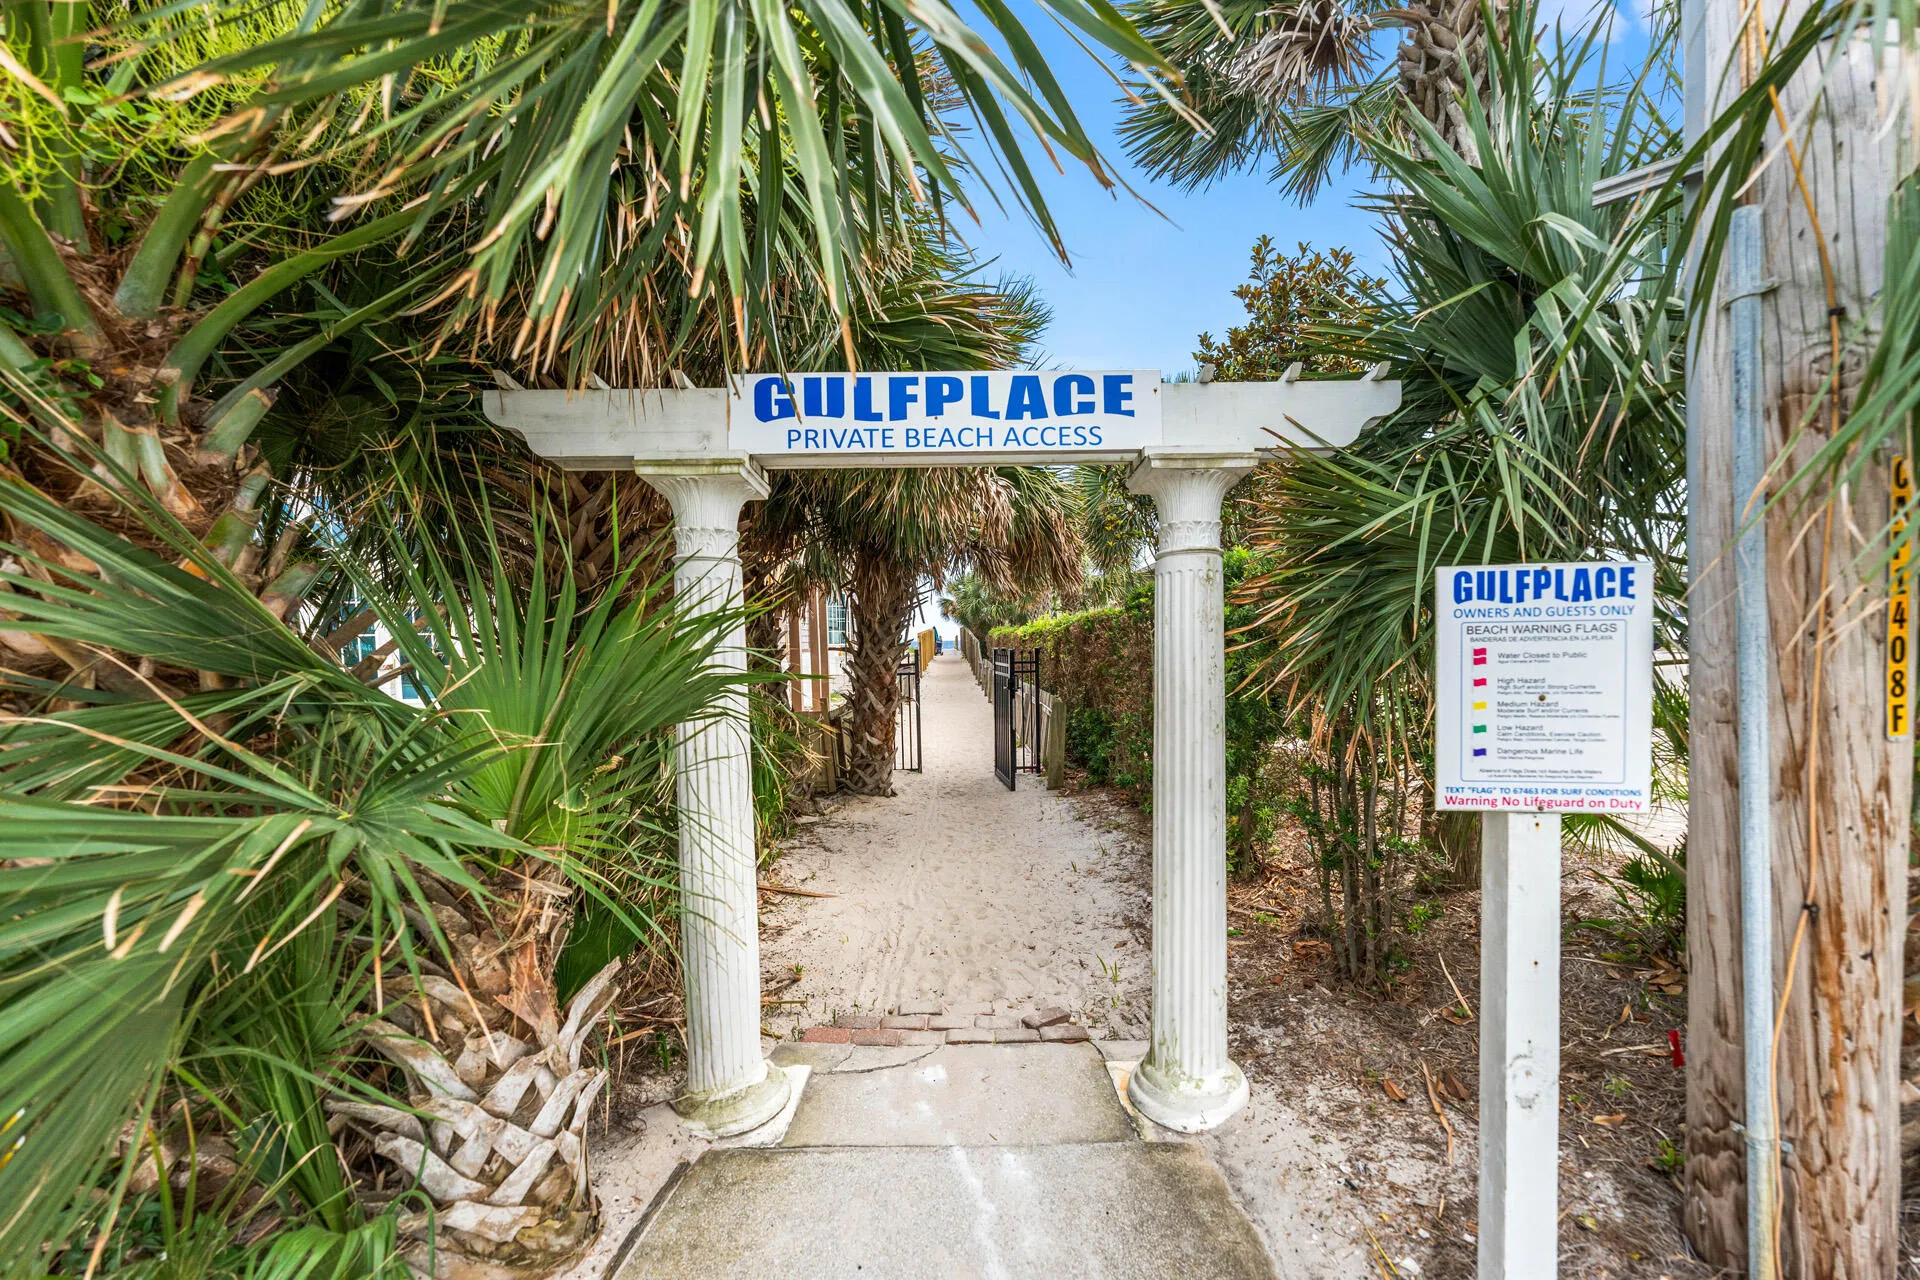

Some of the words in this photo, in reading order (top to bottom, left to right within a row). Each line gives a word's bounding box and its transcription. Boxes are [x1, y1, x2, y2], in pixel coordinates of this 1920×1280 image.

[754, 374, 1135, 423] GULFPLACE
[787, 427, 895, 449] PRIVATE
[905, 426, 993, 448] BEACH
[1003, 425, 1103, 447] ACCESS
[1453, 566, 1635, 605] GULFPLACE
[1453, 607, 1510, 619] OWNERS
[1513, 607, 1543, 618] AND
[1545, 606, 1597, 617] GUESTS
[1600, 605, 1635, 616] ONLY
[1466, 625, 1508, 635] BEACH
[1511, 624, 1572, 634] WARNING
[1575, 623, 1618, 633] FLAGS
[1522, 651, 1551, 659] Closed
[1562, 651, 1588, 659] Public
[1497, 677, 1515, 685] High
[1497, 747, 1538, 755] Dangerous
[1445, 786, 1465, 794] TEXT
[1467, 786, 1497, 795] "FLAG"
[1500, 787, 1511, 795] TO
[1513, 787, 1539, 795] 67463
[1541, 787, 1558, 795] FOR
[1560, 788, 1582, 796] SURF
[1585, 788, 1642, 797] CONDITIONS
[1444, 795, 1498, 809] Warning
[1502, 796, 1520, 806] No
[1524, 796, 1585, 809] Lifeguard
[1588, 800, 1606, 808] on
[1609, 798, 1643, 810] Duty
